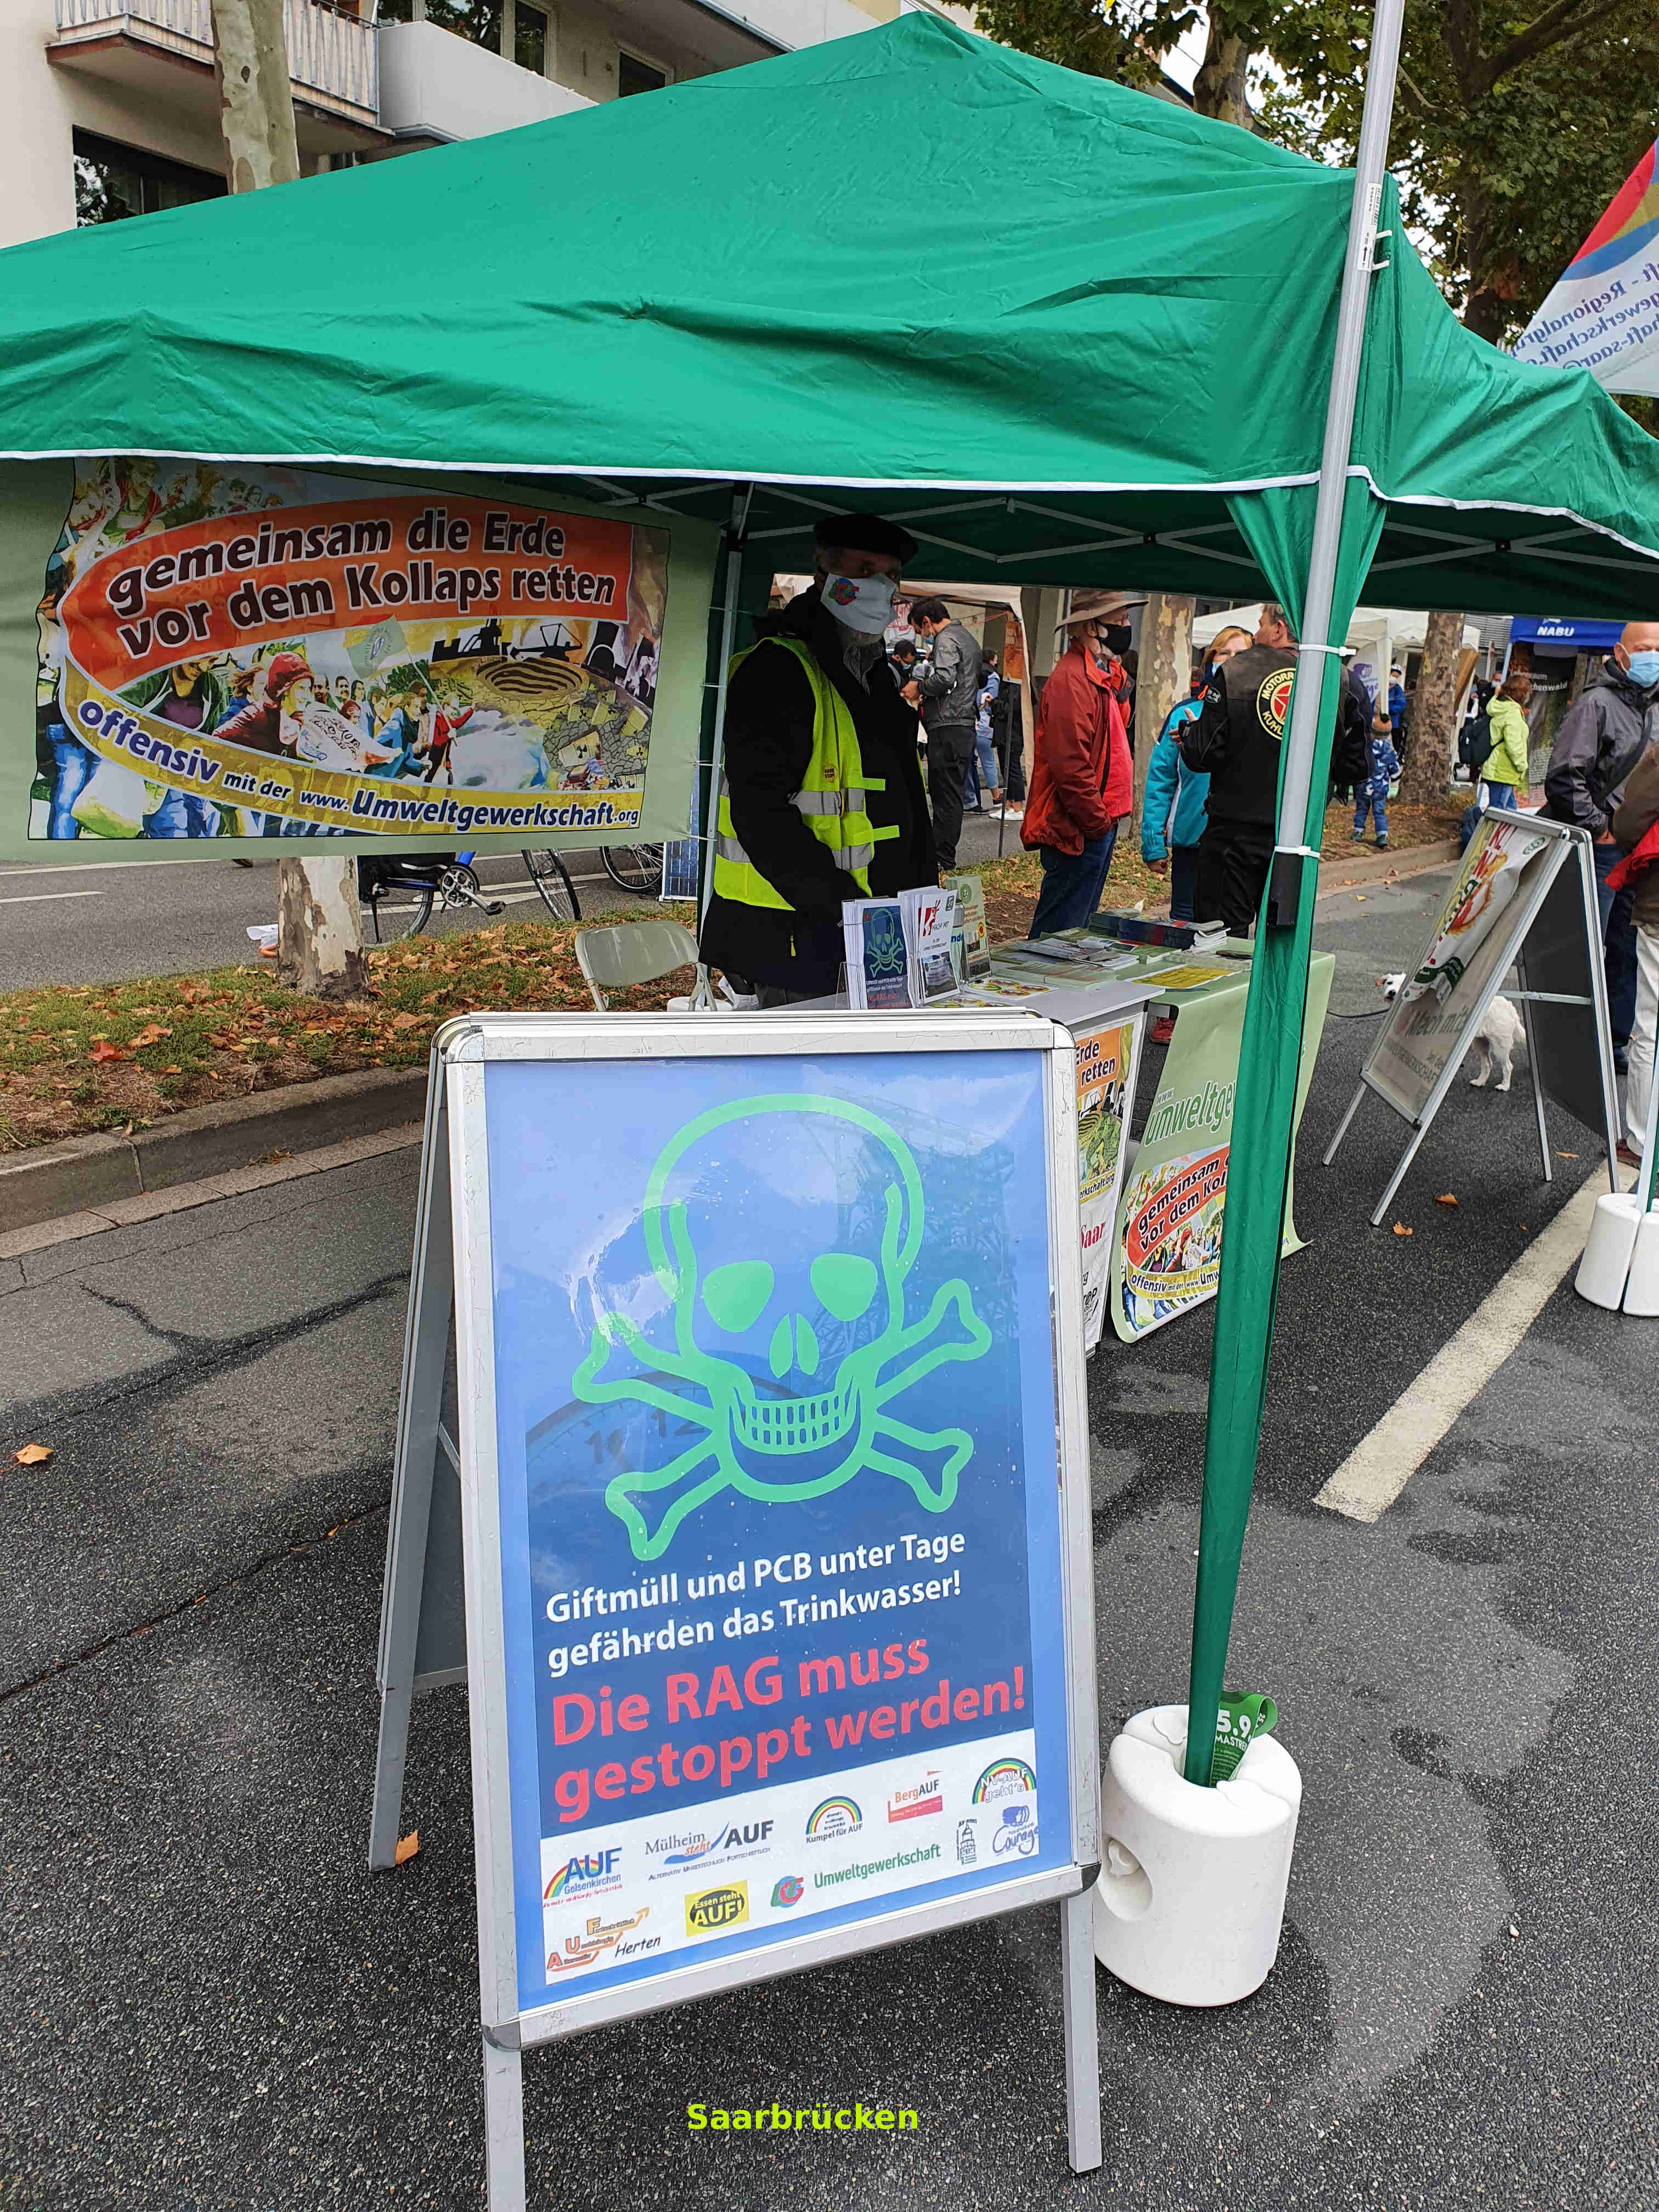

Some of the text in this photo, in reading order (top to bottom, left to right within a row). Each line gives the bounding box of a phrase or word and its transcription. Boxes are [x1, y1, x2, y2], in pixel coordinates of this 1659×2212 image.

[106, 507, 566, 619] gemeinsam die Erde
[116, 559, 616, 659] vor dem Kollaps retten
[1537, 626, 1575, 637] NABU
[78, 699, 221, 784] offensiv
[222, 771, 257, 792] mit
[259, 778, 292, 800] der
[1081, 1057, 1116, 1088] retten
[1144, 1080, 1236, 1148] umweltge
[1138, 1158, 1221, 1237] gemeinsam
[1139, 1217, 1165, 1252] vor
[1169, 1190, 1200, 1224] dem
[1131, 1273, 1167, 1293] offensiv
[546, 1532, 966, 1623] Giftmüll und PCB unter Tage
[548, 1570, 963, 1677] gefährden das Trinkwasser!
[552, 1639, 930, 1746] Die RAG muss
[555, 1665, 1026, 1822] gestoppt werden!
[894, 1779, 940, 1803] BergAUF
[645, 1819, 774, 1855] Mülheim AUF
[684, 1838, 711, 1855] steht
[806, 1822, 864, 1844] Kumpel für AUF
[563, 1847, 623, 1886] AUF
[564, 1874, 622, 1895] Gelsenkirchen
[813, 1843, 942, 1889] Umweltgewerkschaft
[693, 1900, 742, 1927] AUF!
[694, 1894, 719, 1910] Essen
[614, 1936, 661, 1958] Herten
